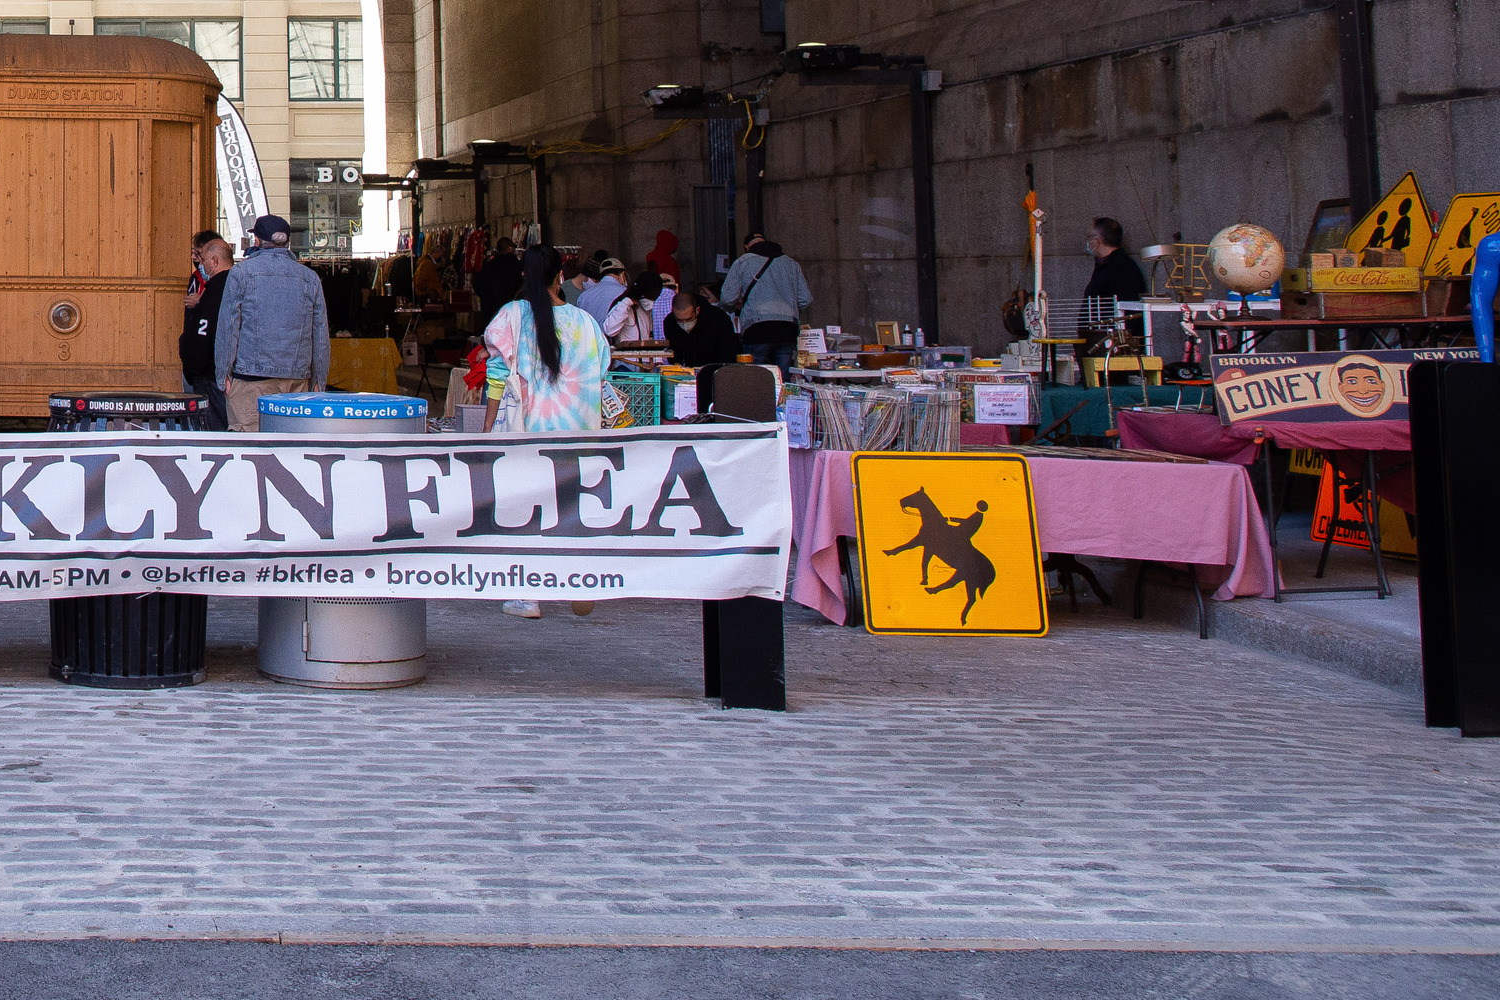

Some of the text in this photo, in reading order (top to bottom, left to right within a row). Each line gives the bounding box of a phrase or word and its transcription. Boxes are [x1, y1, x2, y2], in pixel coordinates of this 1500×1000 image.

[7, 87, 124, 101] DUMBO STATION
[1481, 202, 1500, 234] GOO
[1333, 270, 1389, 286] Coca-Cola
[197, 319, 208, 335] 2
[57, 341, 71, 361] 3
[1218, 350, 1480, 366] BROOKLYN NEW YOR
[1225, 371, 1322, 414] CONEY
[89, 401, 114, 410] DUMBO
[116, 402, 123, 410] IS
[124, 403, 134, 411] AT
[134, 403, 154, 412] YOUR
[155, 402, 186, 411] DISPOSAL
[268, 403, 398, 418] Recycle Recycle
[368, 445, 743, 542] FLEA
[142, 565, 247, 584] @bkflea
[256, 563, 354, 584] #bkflea
[387, 563, 624, 592] brooklynflea.com
